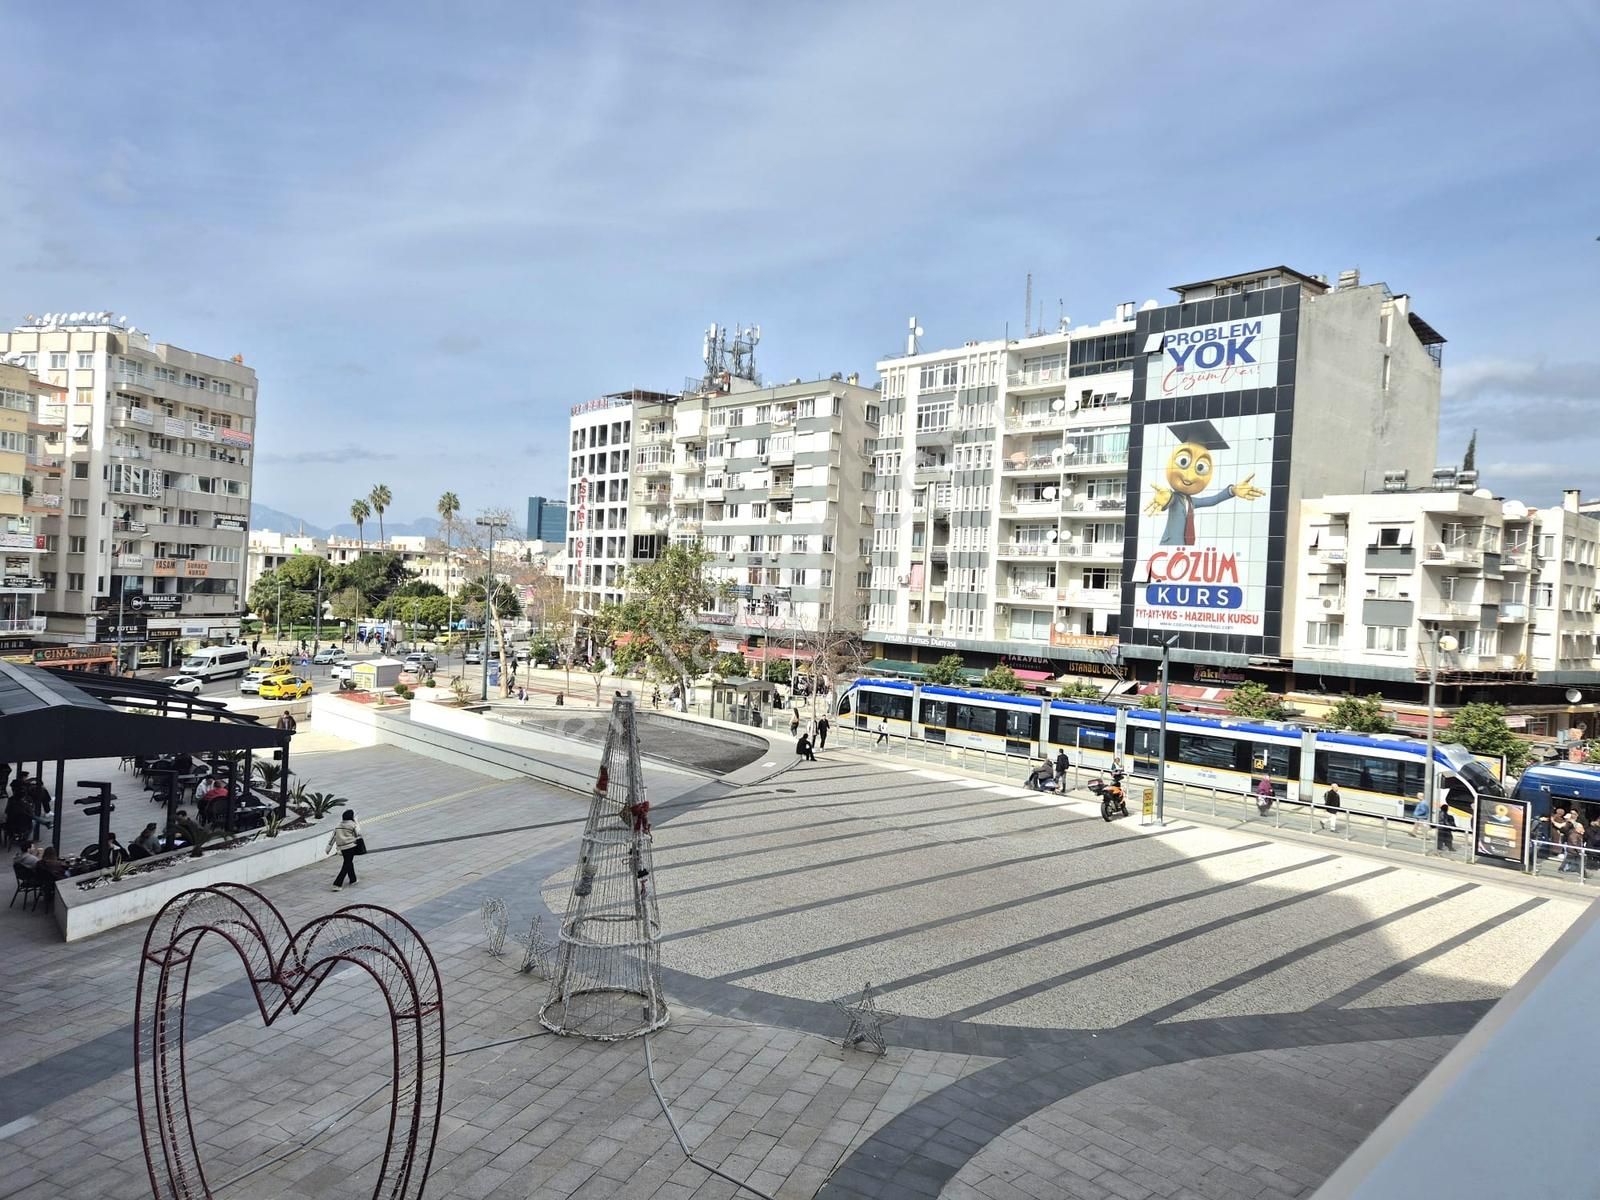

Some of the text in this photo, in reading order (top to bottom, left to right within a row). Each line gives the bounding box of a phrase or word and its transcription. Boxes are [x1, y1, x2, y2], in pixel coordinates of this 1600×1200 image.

[1164, 321, 1261, 348] PROBLEM
[1167, 336, 1257, 372] YOK
[1146, 547, 1239, 583] ÇÖZÜM
[1157, 587, 1229, 606] KURS
[1135, 609, 1178, 620] TYT-AYT-YKS
[1184, 611, 1225, 623] HAZIRLIK
[1228, 614, 1259, 625] KURSU
